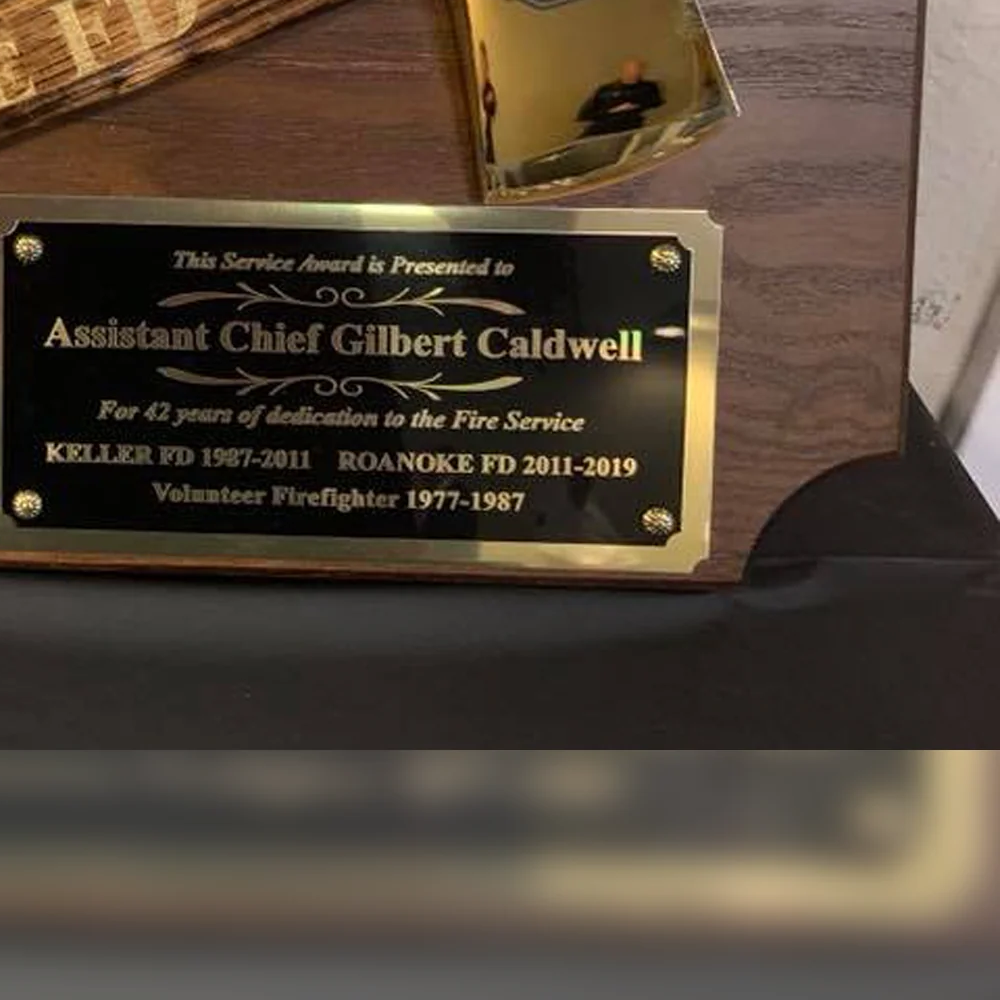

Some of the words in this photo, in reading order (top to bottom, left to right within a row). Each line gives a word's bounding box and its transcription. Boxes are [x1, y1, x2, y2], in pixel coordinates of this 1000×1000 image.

[172, 250, 217, 270] This
[220, 252, 294, 272] Service
[297, 254, 364, 274] Award
[367, 255, 385, 274] is
[389, 256, 489, 276] Presented
[494, 258, 515, 276] to
[43, 316, 210, 351] Assistant
[219, 320, 324, 355] Chief
[330, 323, 468, 358] Gilbert
[476, 327, 643, 362] Caldwell
[97, 400, 139, 421] For
[143, 402, 171, 421] 42
[172, 406, 233, 427] years
[237, 405, 266, 428] of
[266, 405, 378, 427] dedication
[384, 409, 405, 428] to
[410, 409, 446, 430] the
[450, 410, 499, 431] Fire
[503, 411, 586, 432] Service
[45, 442, 153, 465] KELLER
[158, 446, 195, 467] FD
[201, 447, 311, 470] 1987-2011
[337, 451, 475, 474] ROANOKE
[481, 453, 517, 474] FD
[522, 455, 638, 478] 2011-2019
[152, 482, 267, 505] Volunteer
[271, 485, 400, 513] Firefighter
[407, 489, 526, 513] 1977-1987
